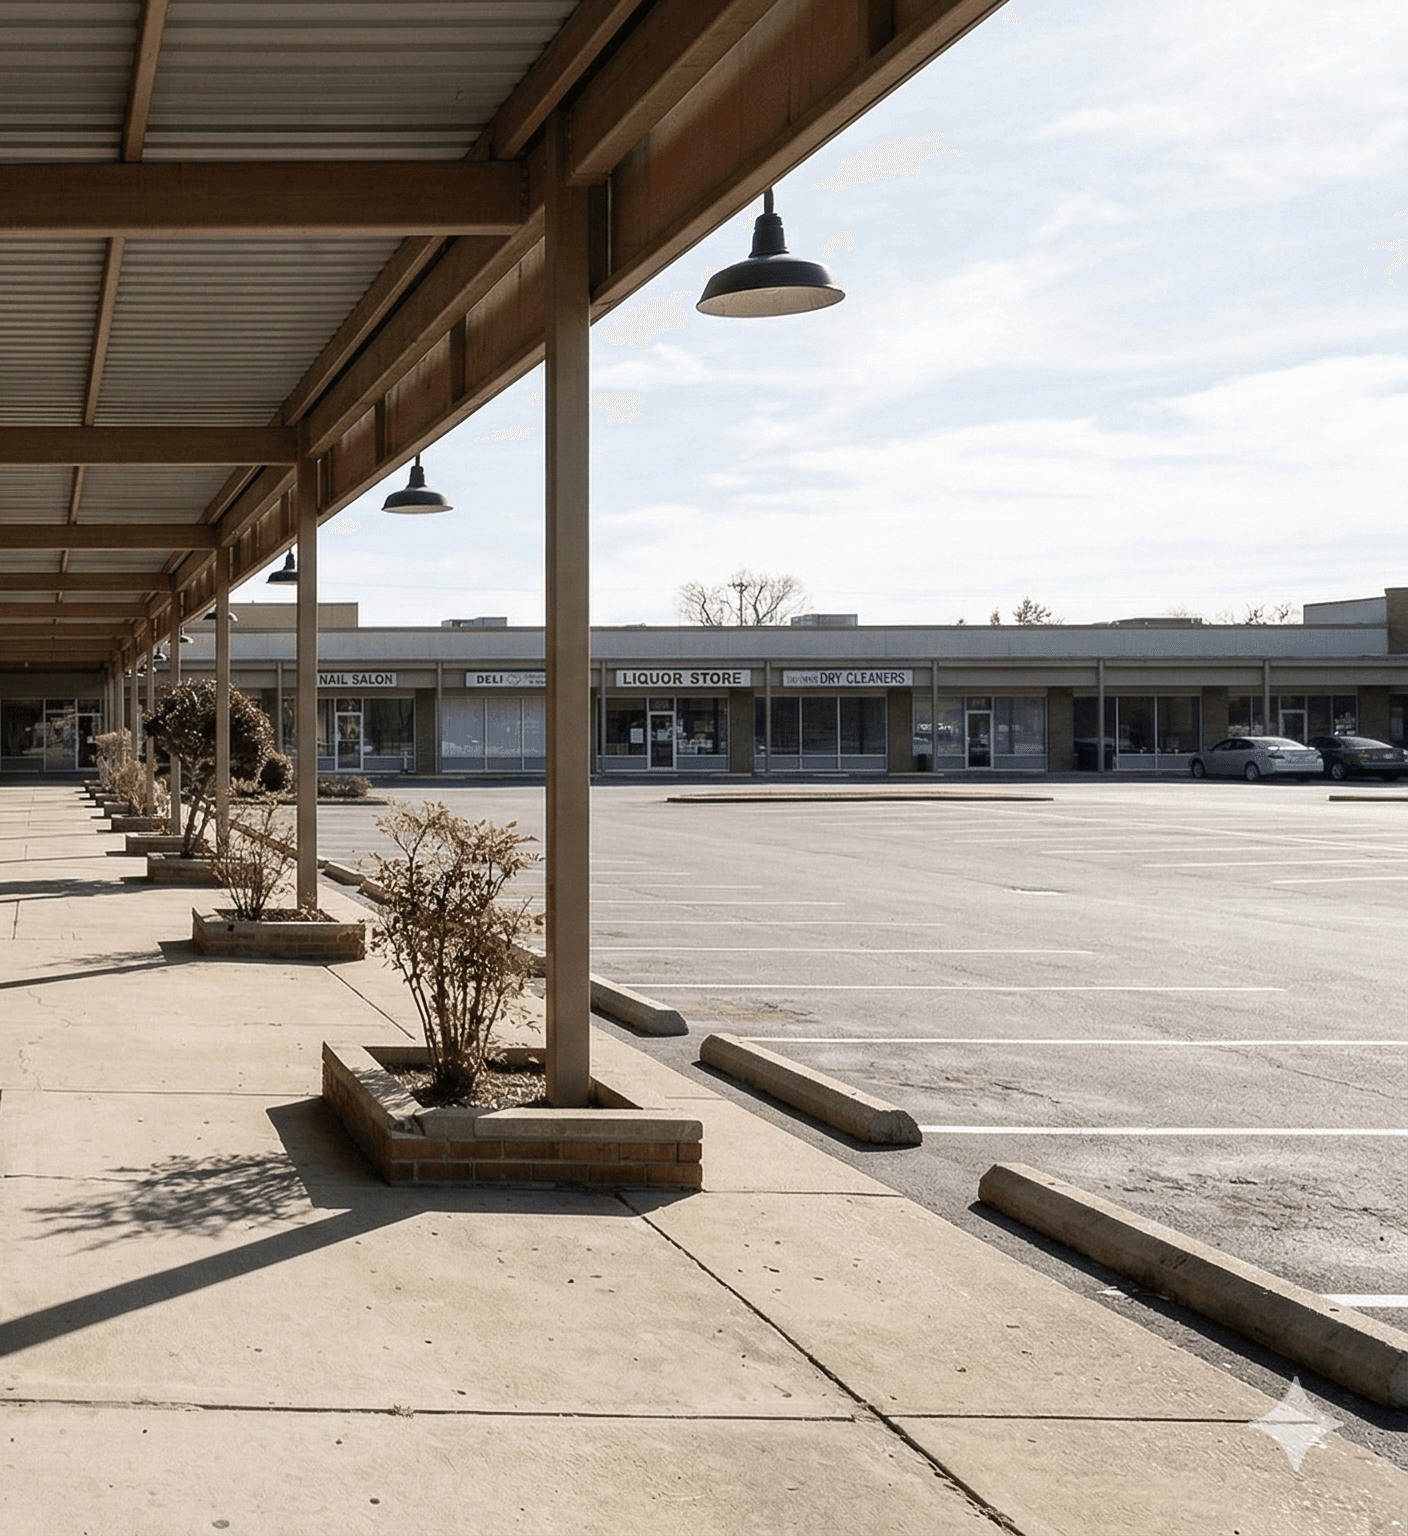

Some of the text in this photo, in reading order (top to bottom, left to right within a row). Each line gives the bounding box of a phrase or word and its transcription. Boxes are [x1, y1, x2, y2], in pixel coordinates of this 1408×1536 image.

[319, 674, 393, 685] NAIL SALON
[476, 675, 503, 684] DELI
[623, 672, 742, 686] LIQUOR STORE
[820, 672, 842, 684] DRY
[846, 672, 905, 684] CLEANERS
